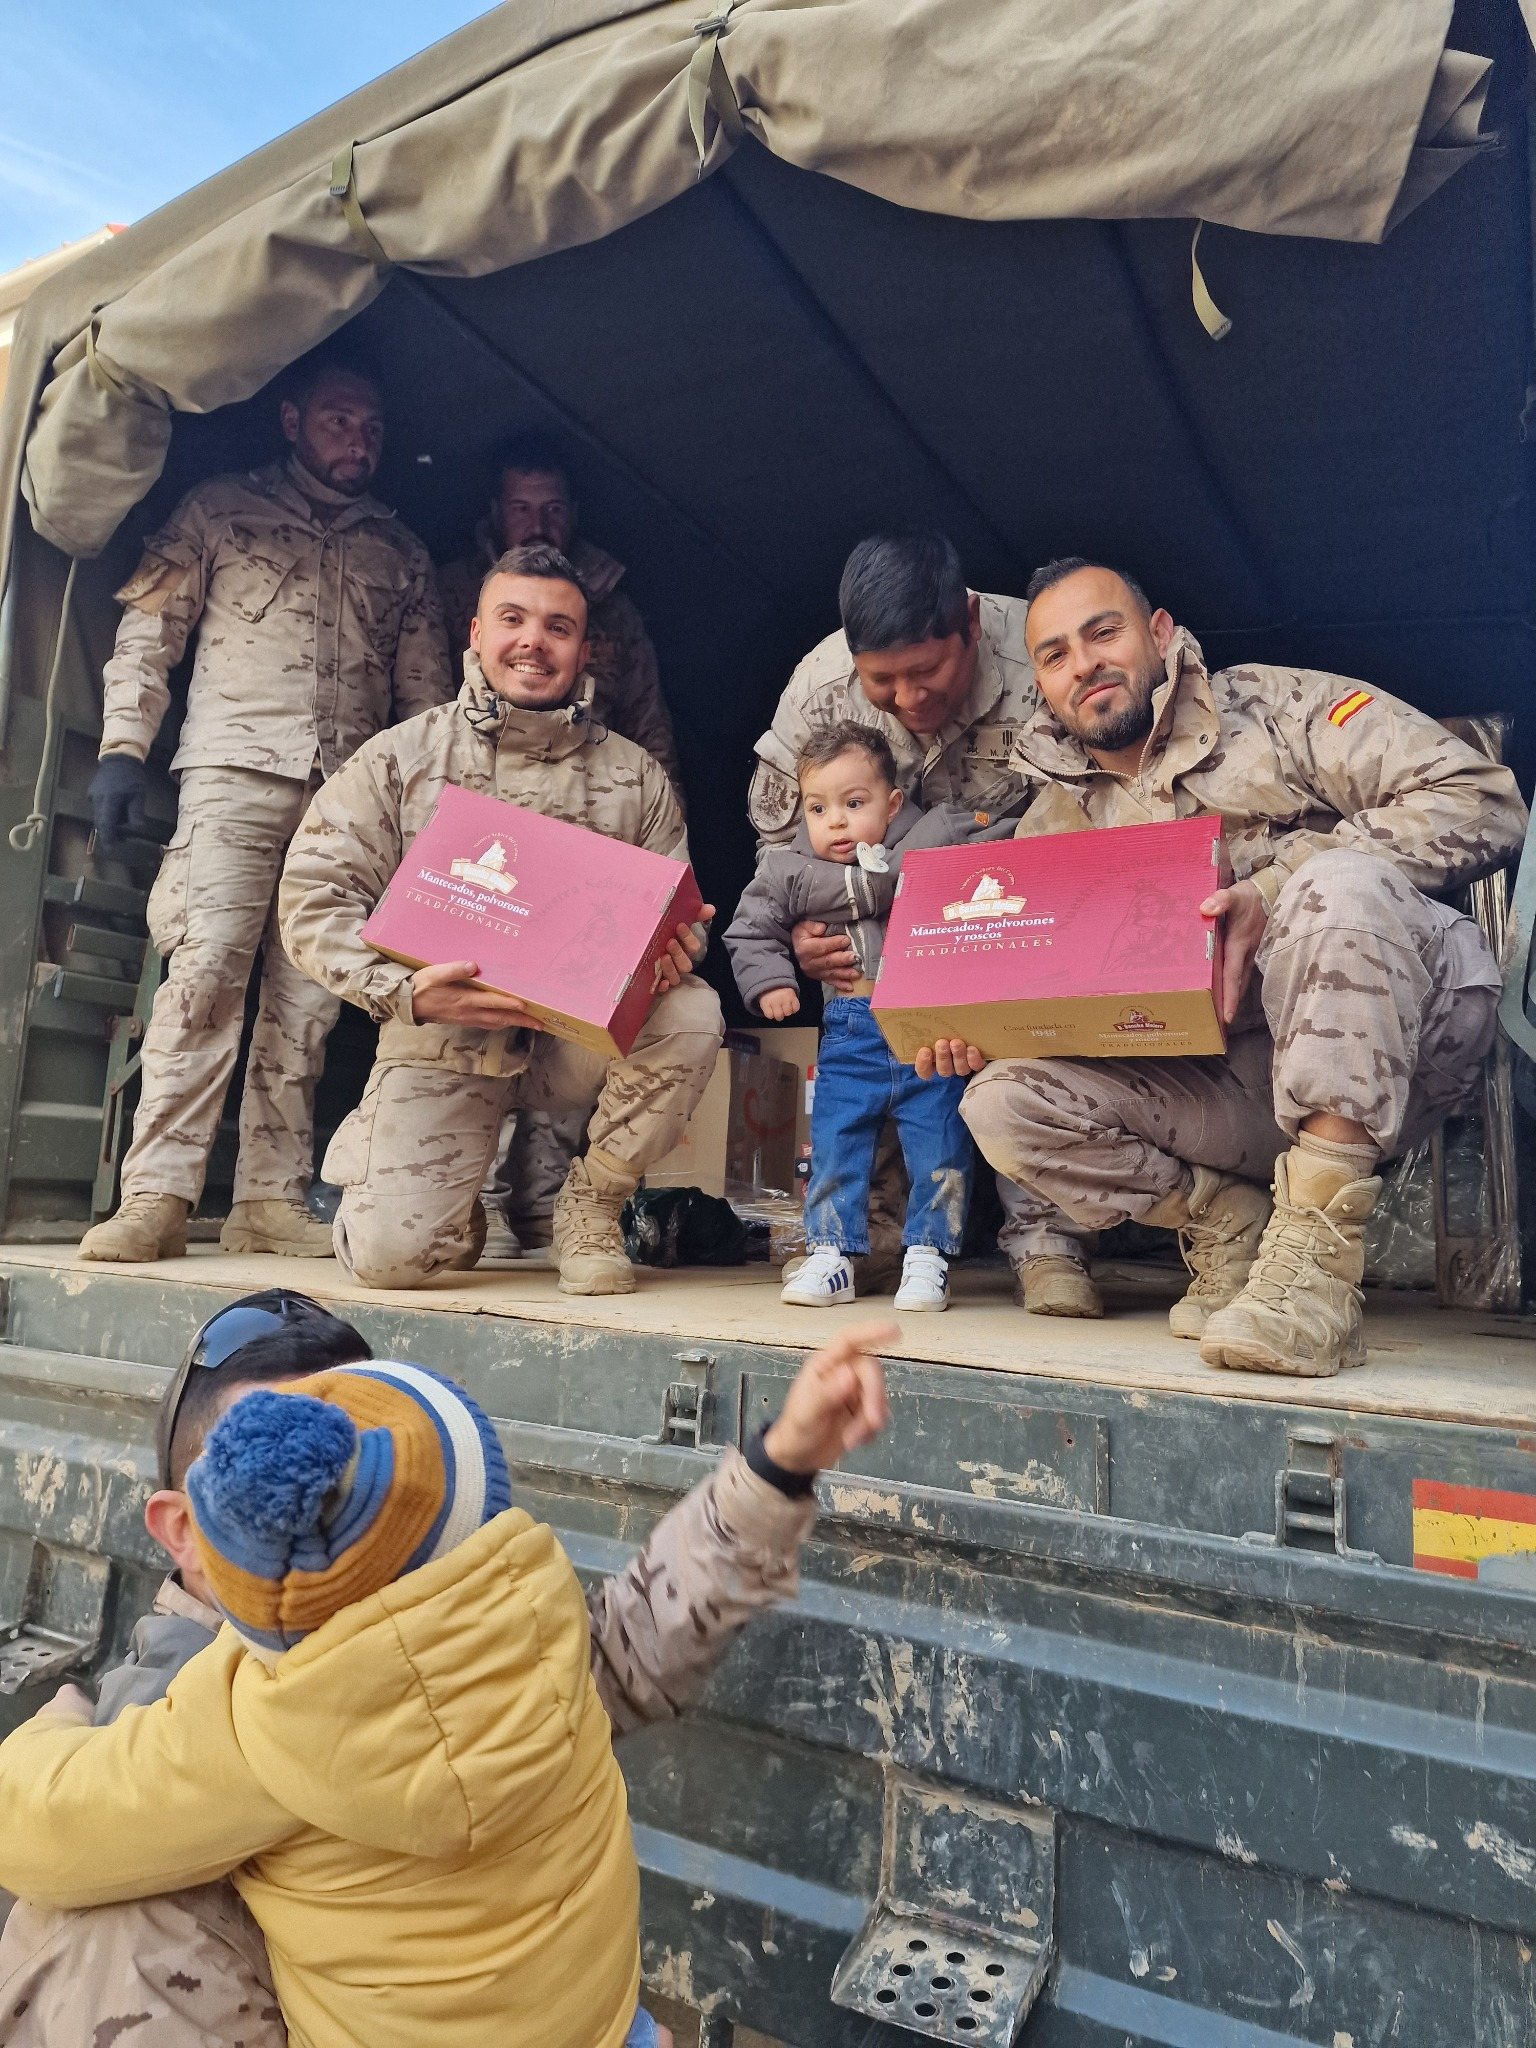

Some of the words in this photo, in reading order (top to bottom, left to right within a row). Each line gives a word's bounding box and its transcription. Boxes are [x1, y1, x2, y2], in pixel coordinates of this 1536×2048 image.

[417, 869, 476, 898] Mantecados,
[476, 893, 530, 916] polvorones
[448, 893, 457, 904] y
[456, 898, 487, 913] roscos
[405, 891, 520, 937] TRADICIONALES
[910, 922, 984, 937] Mantecados,
[986, 917, 1055, 932] polvorones
[904, 938, 1053, 958] TRADICIONALES
[954, 934, 962, 945] y
[964, 931, 1002, 941] roscos
